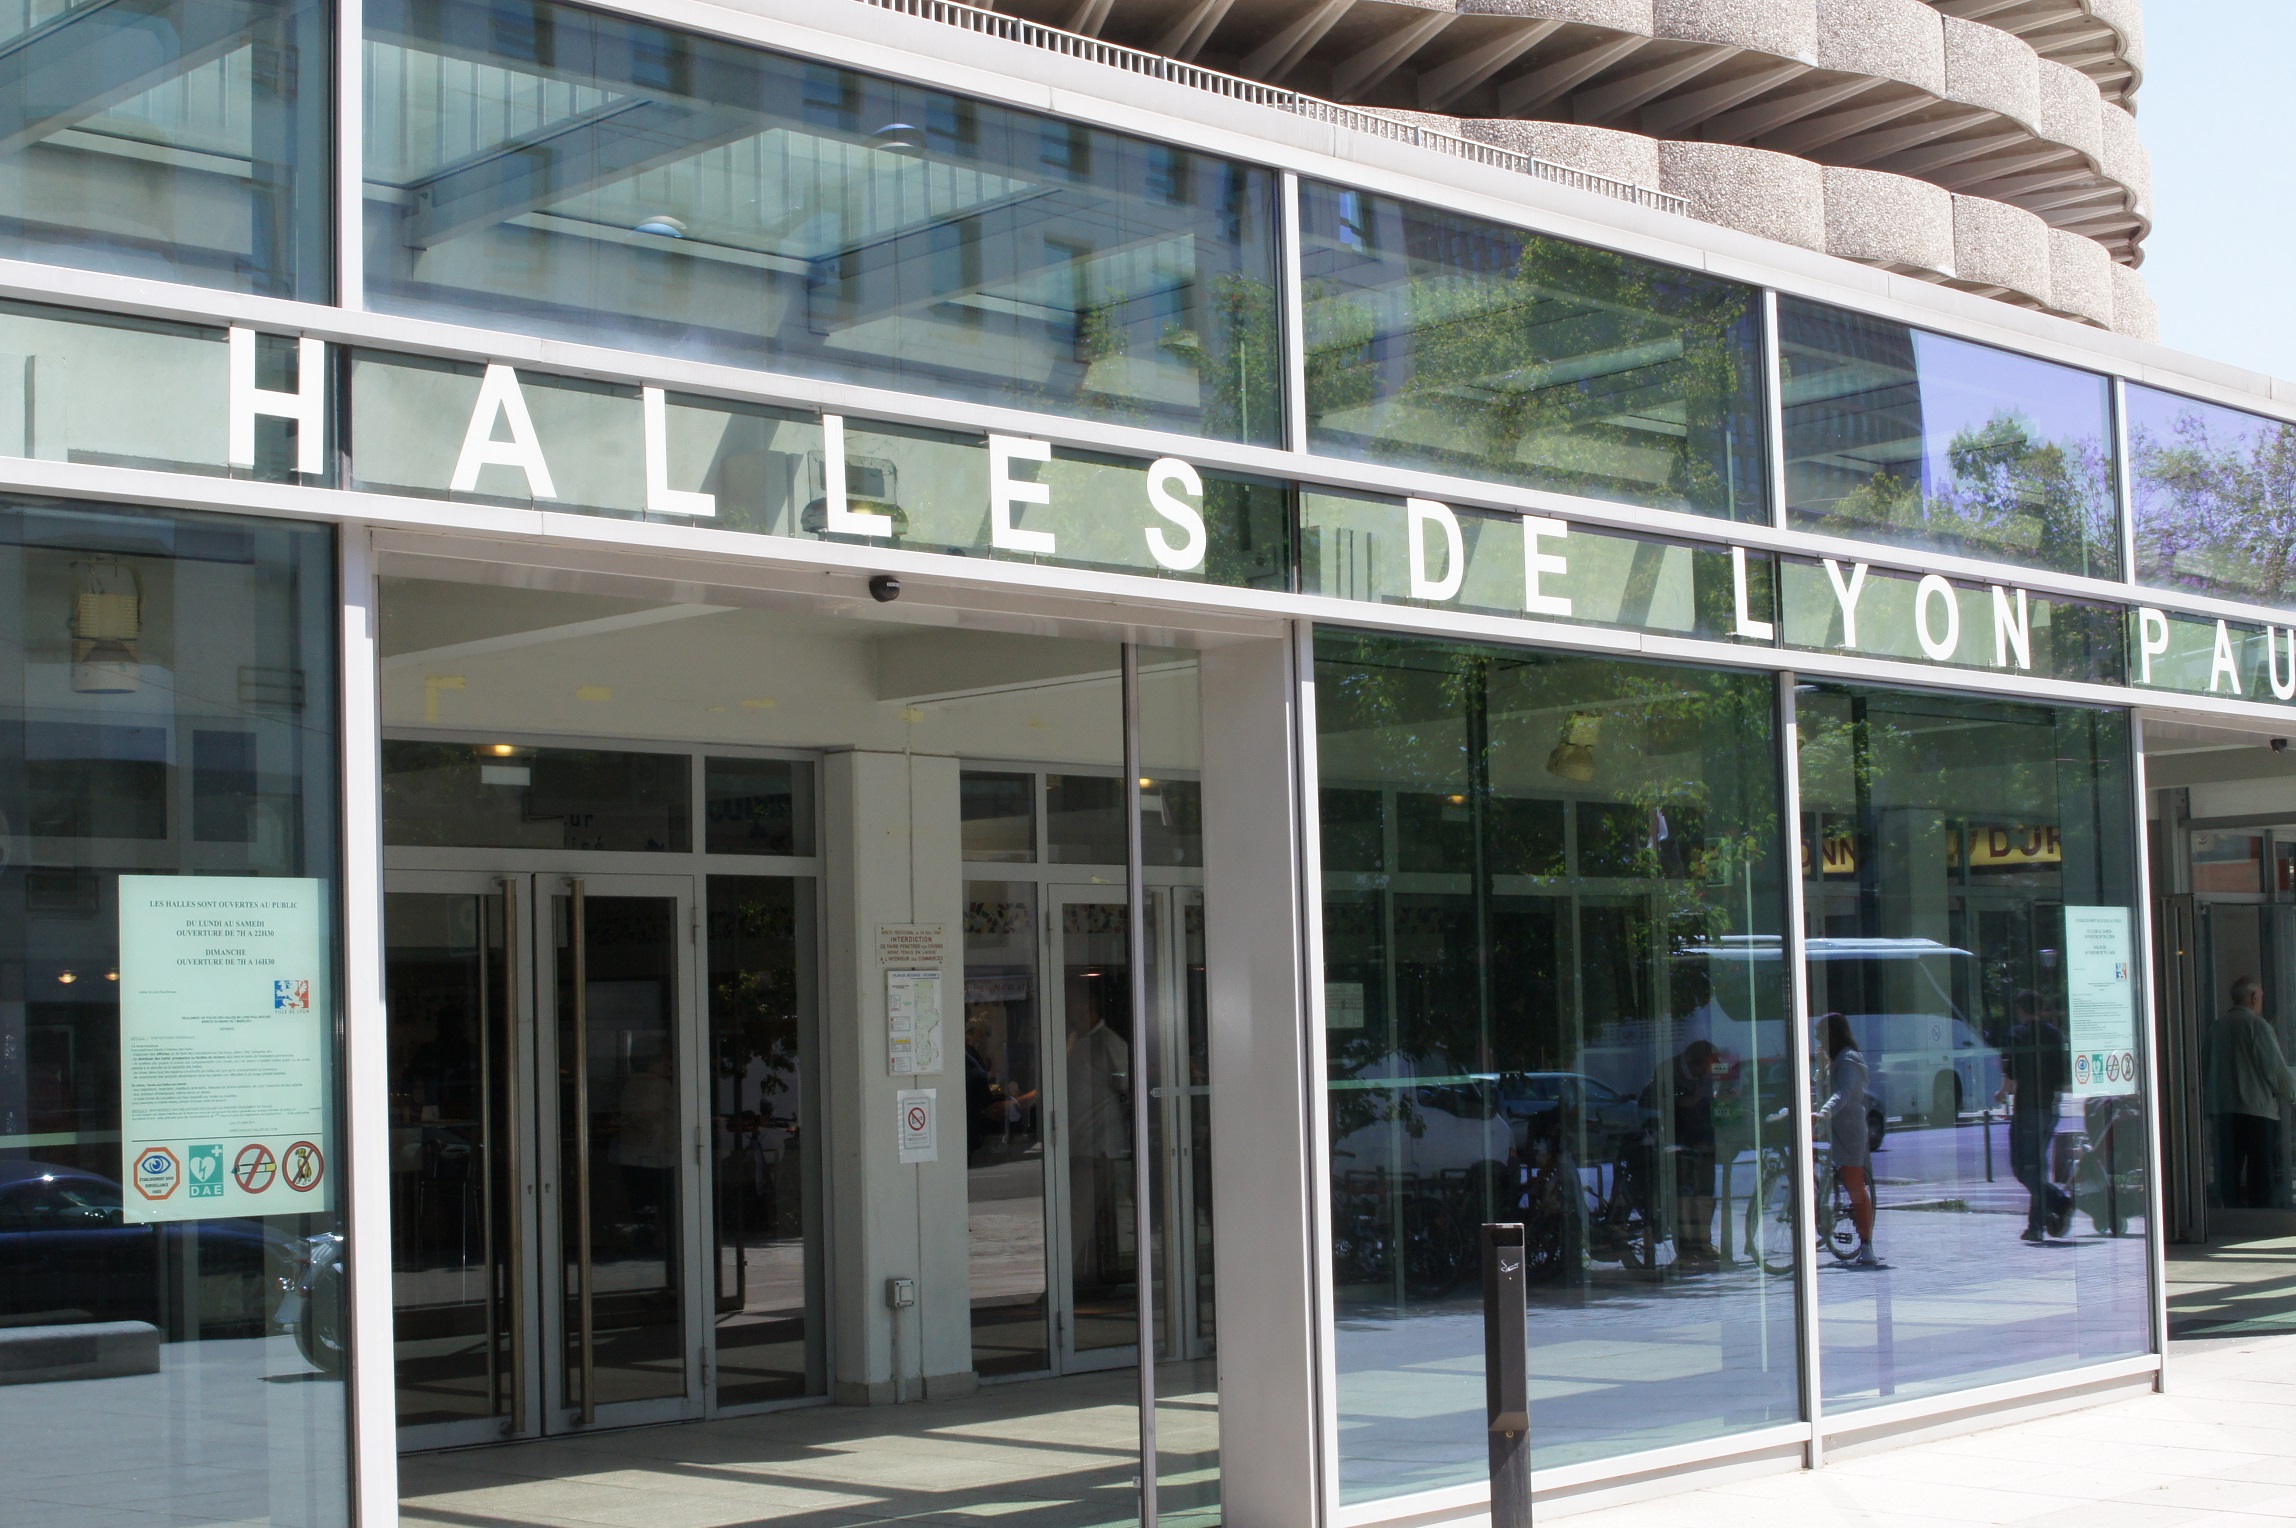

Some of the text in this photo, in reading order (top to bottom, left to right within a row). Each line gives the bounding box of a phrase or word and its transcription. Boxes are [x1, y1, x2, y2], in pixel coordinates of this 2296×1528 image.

[229, 326, 1207, 572] HALLES
[1406, 497, 1573, 617] DE
[1731, 546, 2031, 670] LYON
[150, 900, 299, 909] LES HALLES SONT OUVERTES AU PUBLIC
[235, 920, 265, 928] SAMEDI
[176, 958, 275, 966] OUVERTURE DE 7H A 16H30
[190, 1185, 222, 1196] DAE
